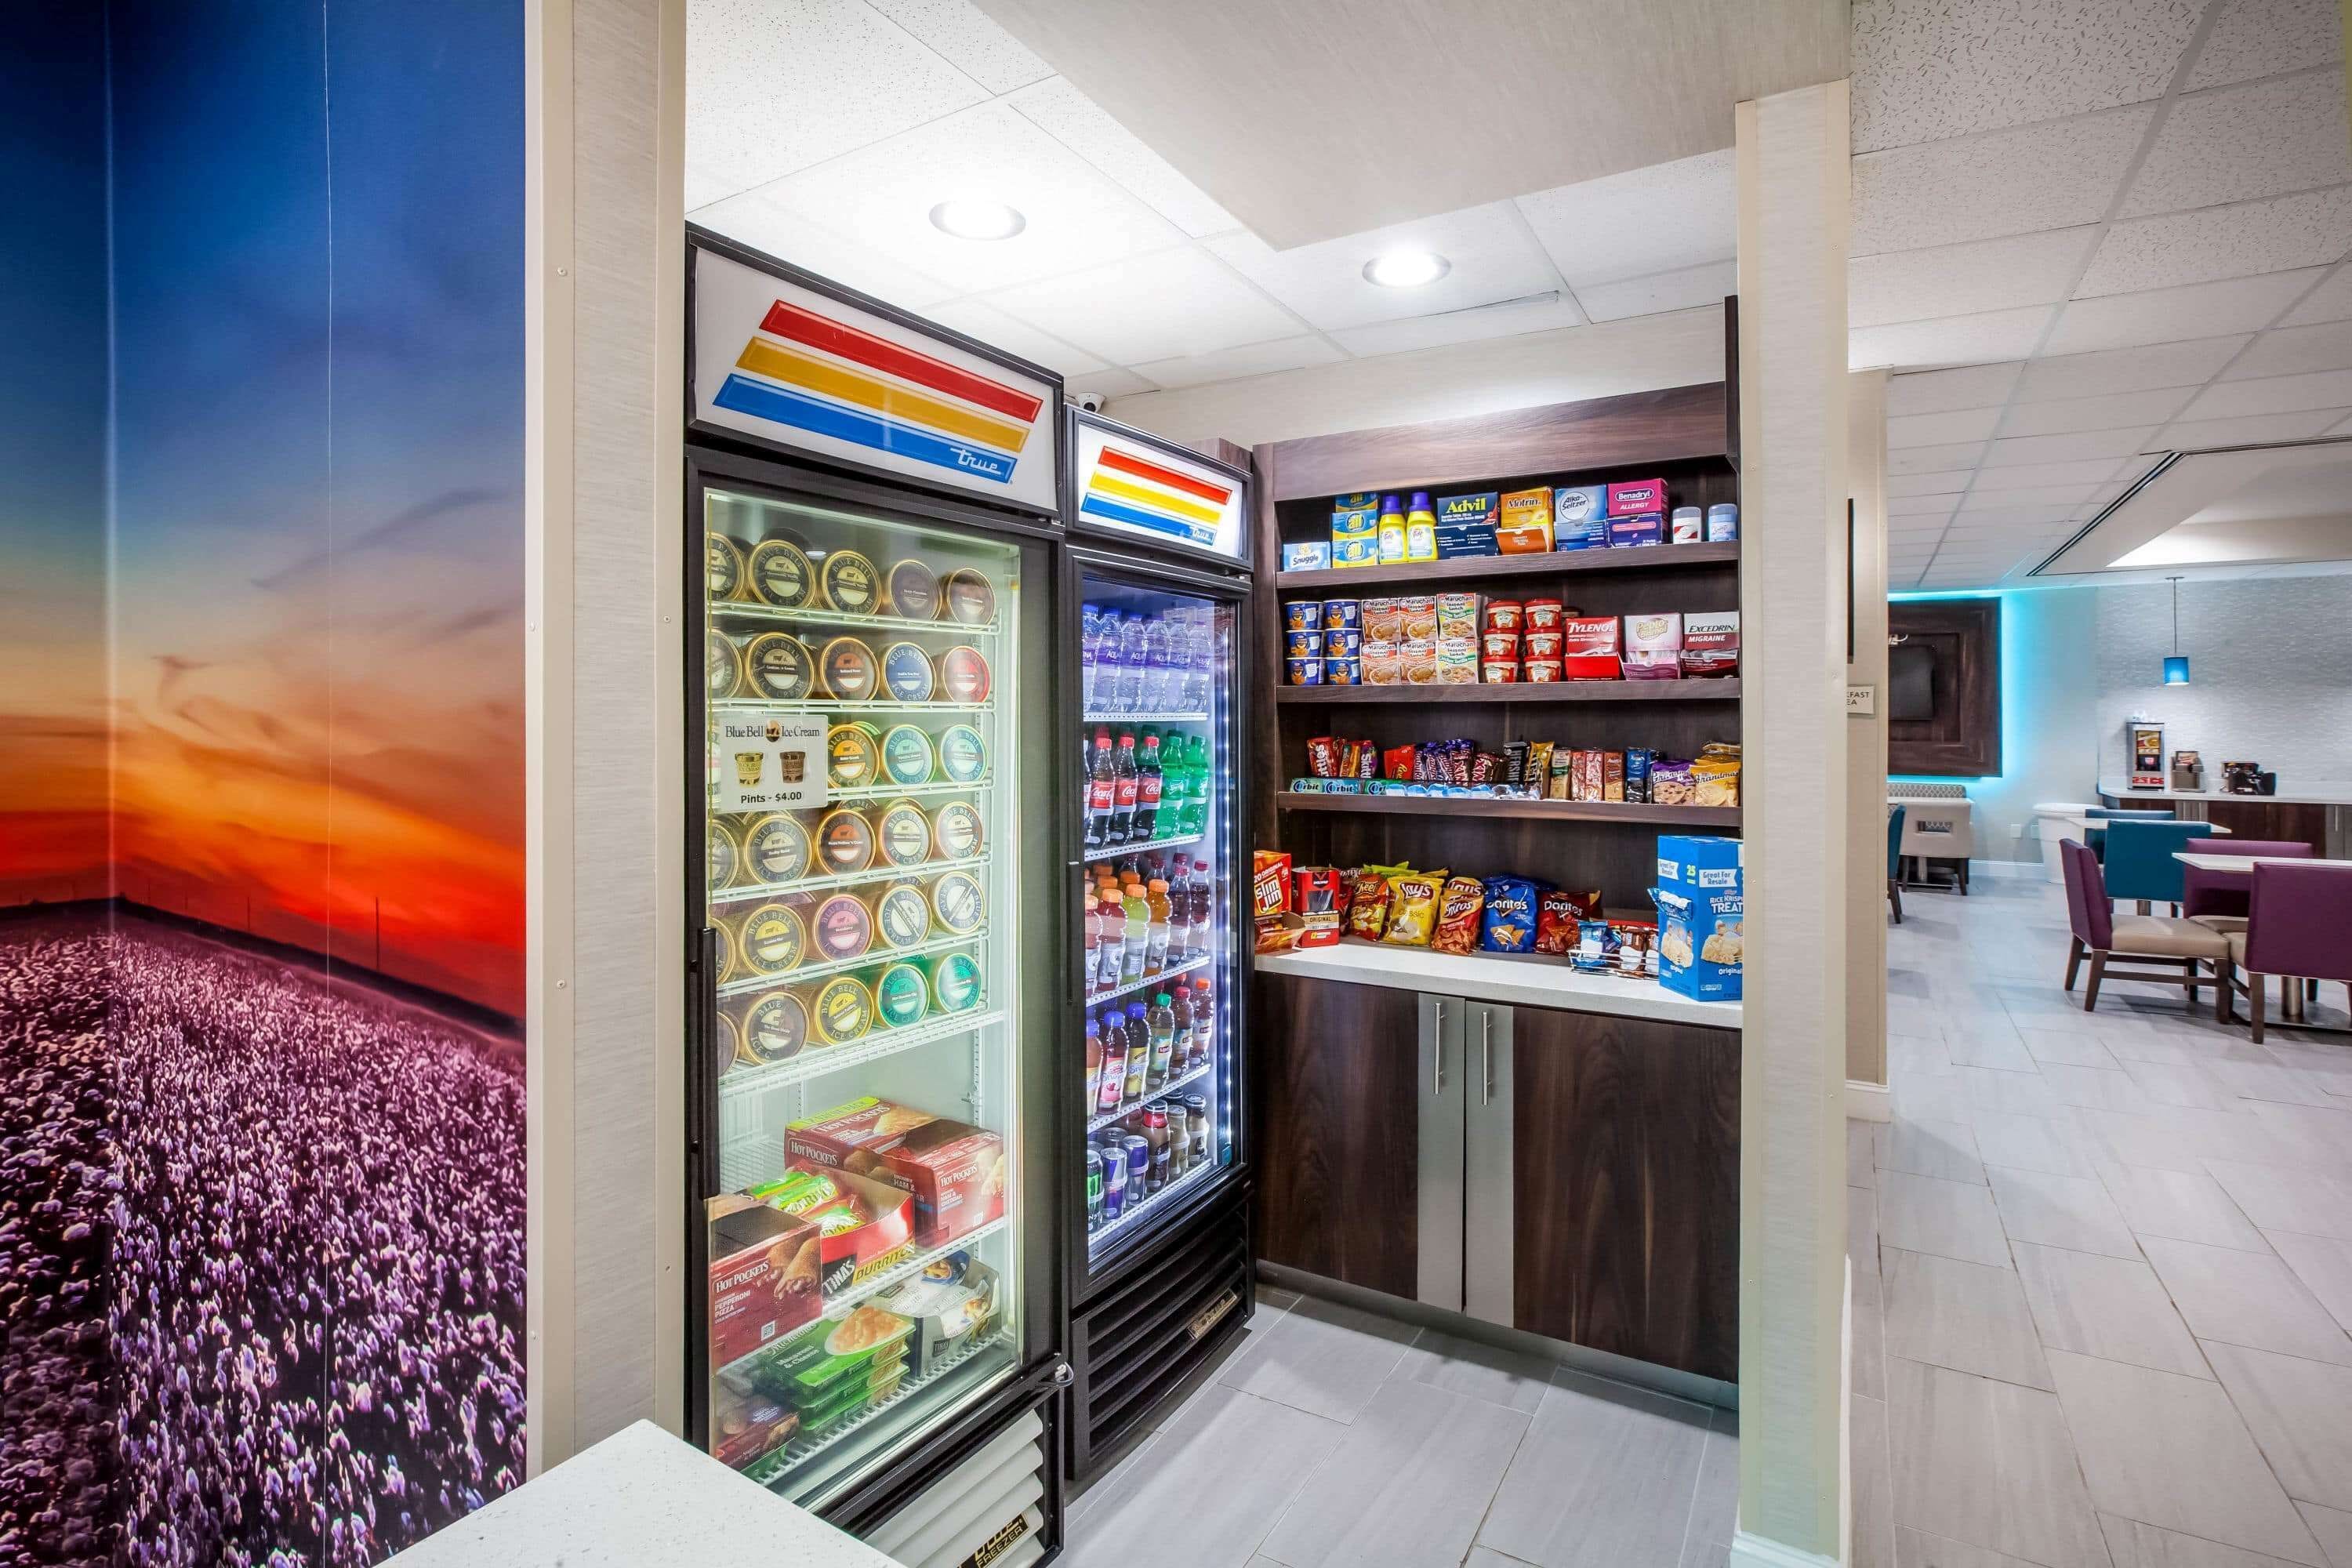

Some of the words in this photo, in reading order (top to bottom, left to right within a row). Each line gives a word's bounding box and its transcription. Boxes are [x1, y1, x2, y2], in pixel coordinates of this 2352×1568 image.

[1618, 490, 1651, 500] Benadryl
[1446, 497, 1486, 514] Advil
[1507, 497, 1538, 509] Motrin
[1562, 499, 1587, 510] Seltzer
[1620, 502, 1650, 510] ALLERGY
[1293, 554, 1319, 565] Snuggle
[1568, 622, 1615, 633] TYLENOL
[1688, 624, 1735, 633] EXCEDRIN
[1688, 634, 1726, 643] MIGRAINE
[725, 725, 745, 738] Blue
[746, 725, 764, 737] Bell
[782, 726, 793, 737] Ice
[793, 726, 820, 737] Cream
[1293, 780, 1319, 793] Orbit
[1325, 781, 1355, 794] Orbit
[741, 794, 766, 804] Pints
[775, 791, 802, 802] $4.00
[1261, 862, 1284, 877] ORIGINAL
[1443, 901, 1473, 919] Fritos
[1486, 898, 1528, 910] Doritos
[1544, 900, 1584, 917] Doritos
[757, 1000, 784, 1017] BLUE
[817, 1120, 842, 1133] HOT
[841, 1104, 891, 1124] POCKETS
[791, 1141, 805, 1155] HOT
[805, 1146, 838, 1166] POCKETS
[941, 1175, 953, 1186] HOT
[953, 1164, 978, 1181] POCKETS
[894, 1178, 910, 1191] HAM
[716, 1278, 734, 1294] HOT
[733, 1261, 769, 1285] POCKETS
[714, 1290, 751, 1312] PEPPERONI
[714, 1305, 735, 1318] PIZZA
